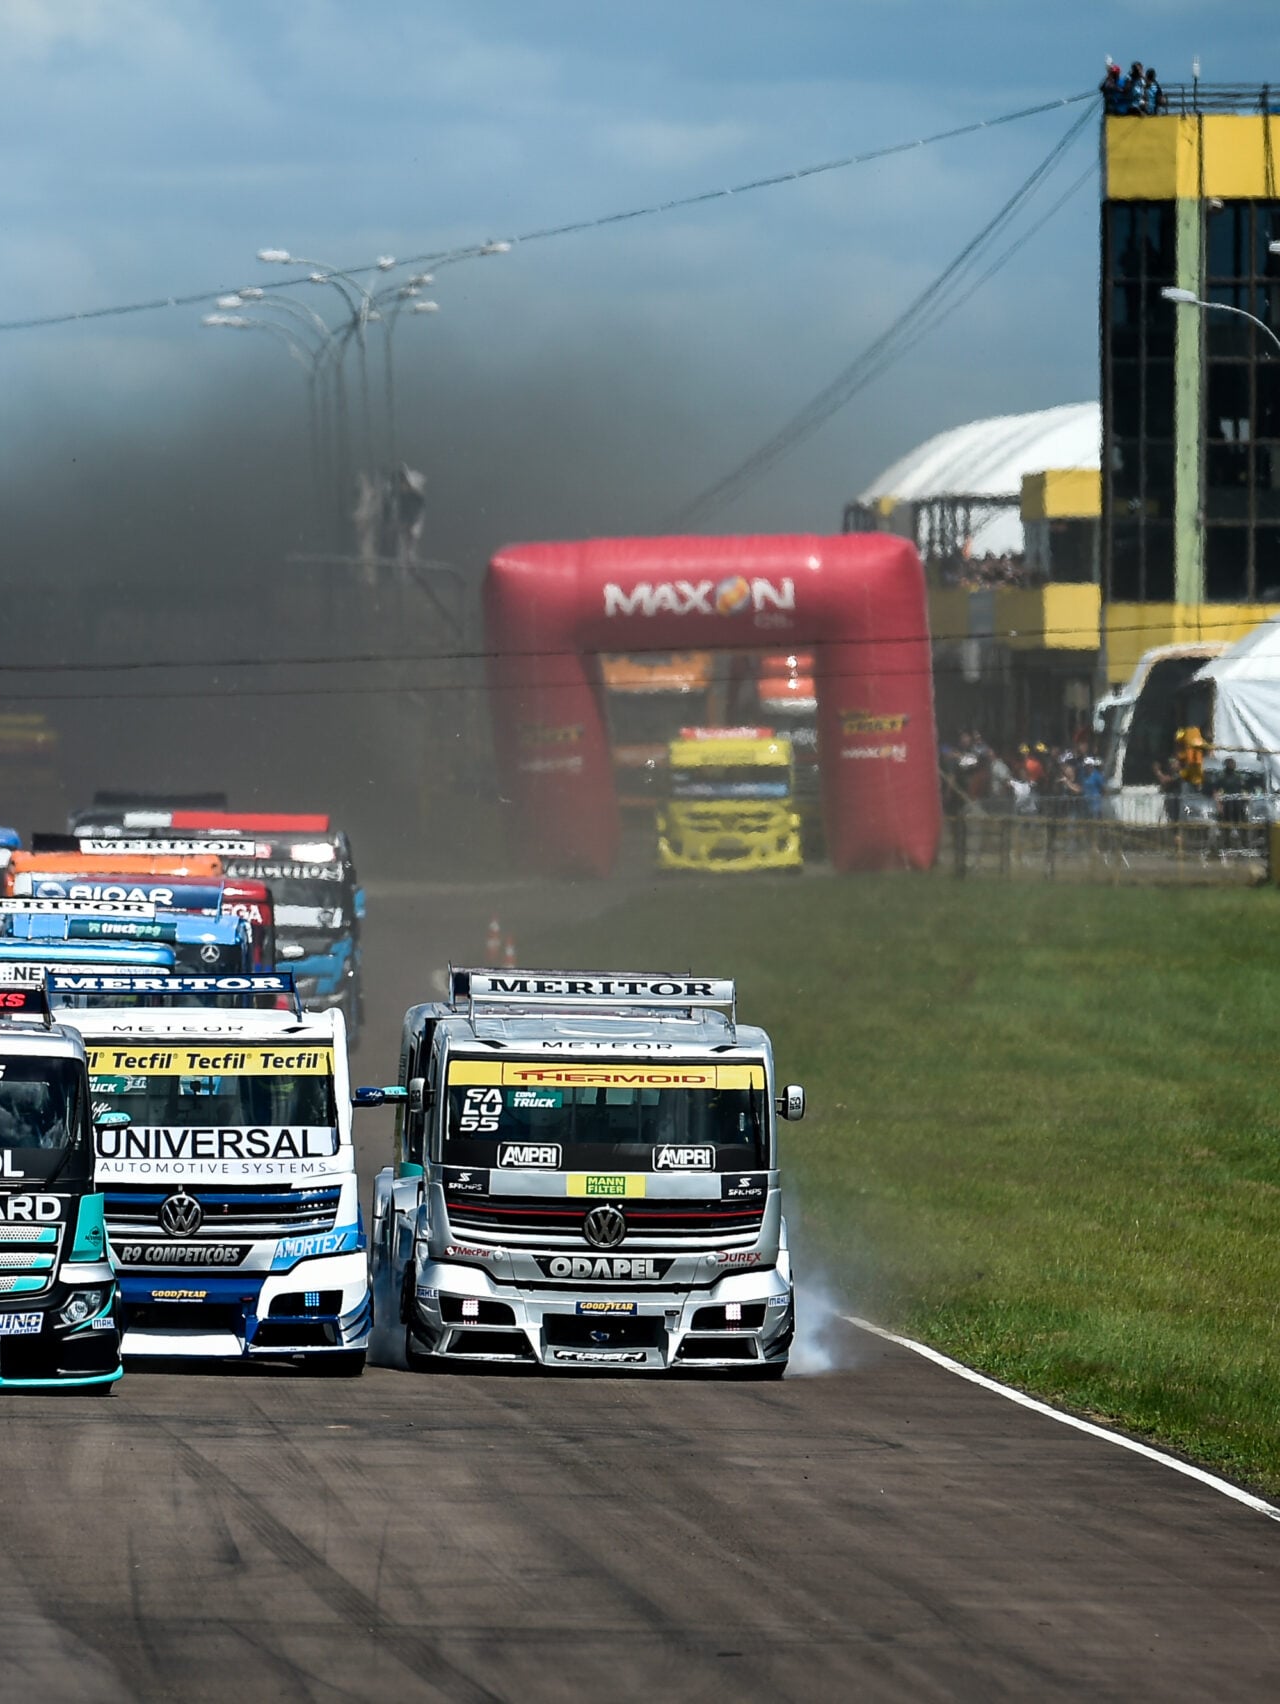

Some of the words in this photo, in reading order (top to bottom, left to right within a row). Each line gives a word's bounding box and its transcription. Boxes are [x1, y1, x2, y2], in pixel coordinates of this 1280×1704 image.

[603, 576, 795, 617] MAXON
[90, 840, 246, 851] MERITOR
[54, 976, 284, 990] MERITOR
[488, 978, 715, 996] MERITOR
[542, 1041, 673, 1050] METEOR
[112, 1052, 172, 1069] Tecfil
[186, 1053, 246, 1070] Tecfil
[260, 1053, 320, 1070] Tecfil
[513, 1067, 706, 1084] THERMOID
[90, 1083, 118, 1093] UCK
[513, 1099, 556, 1107] TRUCK
[96, 1128, 323, 1158] UNIVERSAL
[501, 1147, 557, 1166] AMPRI
[657, 1148, 711, 1168] AMPRI
[100, 1162, 229, 1174] AUTOMOTIVE
[241, 1162, 326, 1174] SYSTEMS
[588, 1177, 624, 1185] MANN
[588, 1186, 624, 1194] FILTER
[275, 1233, 345, 1259] AMORTEX
[457, 1248, 490, 1257] MecPar
[121, 1246, 140, 1262] R9
[145, 1244, 240, 1265] COMPETIÇÕES
[549, 1257, 660, 1278] ODAPEL
[151, 1289, 207, 1299] GOODYEAR
[579, 1302, 634, 1312] GOODYEAR
